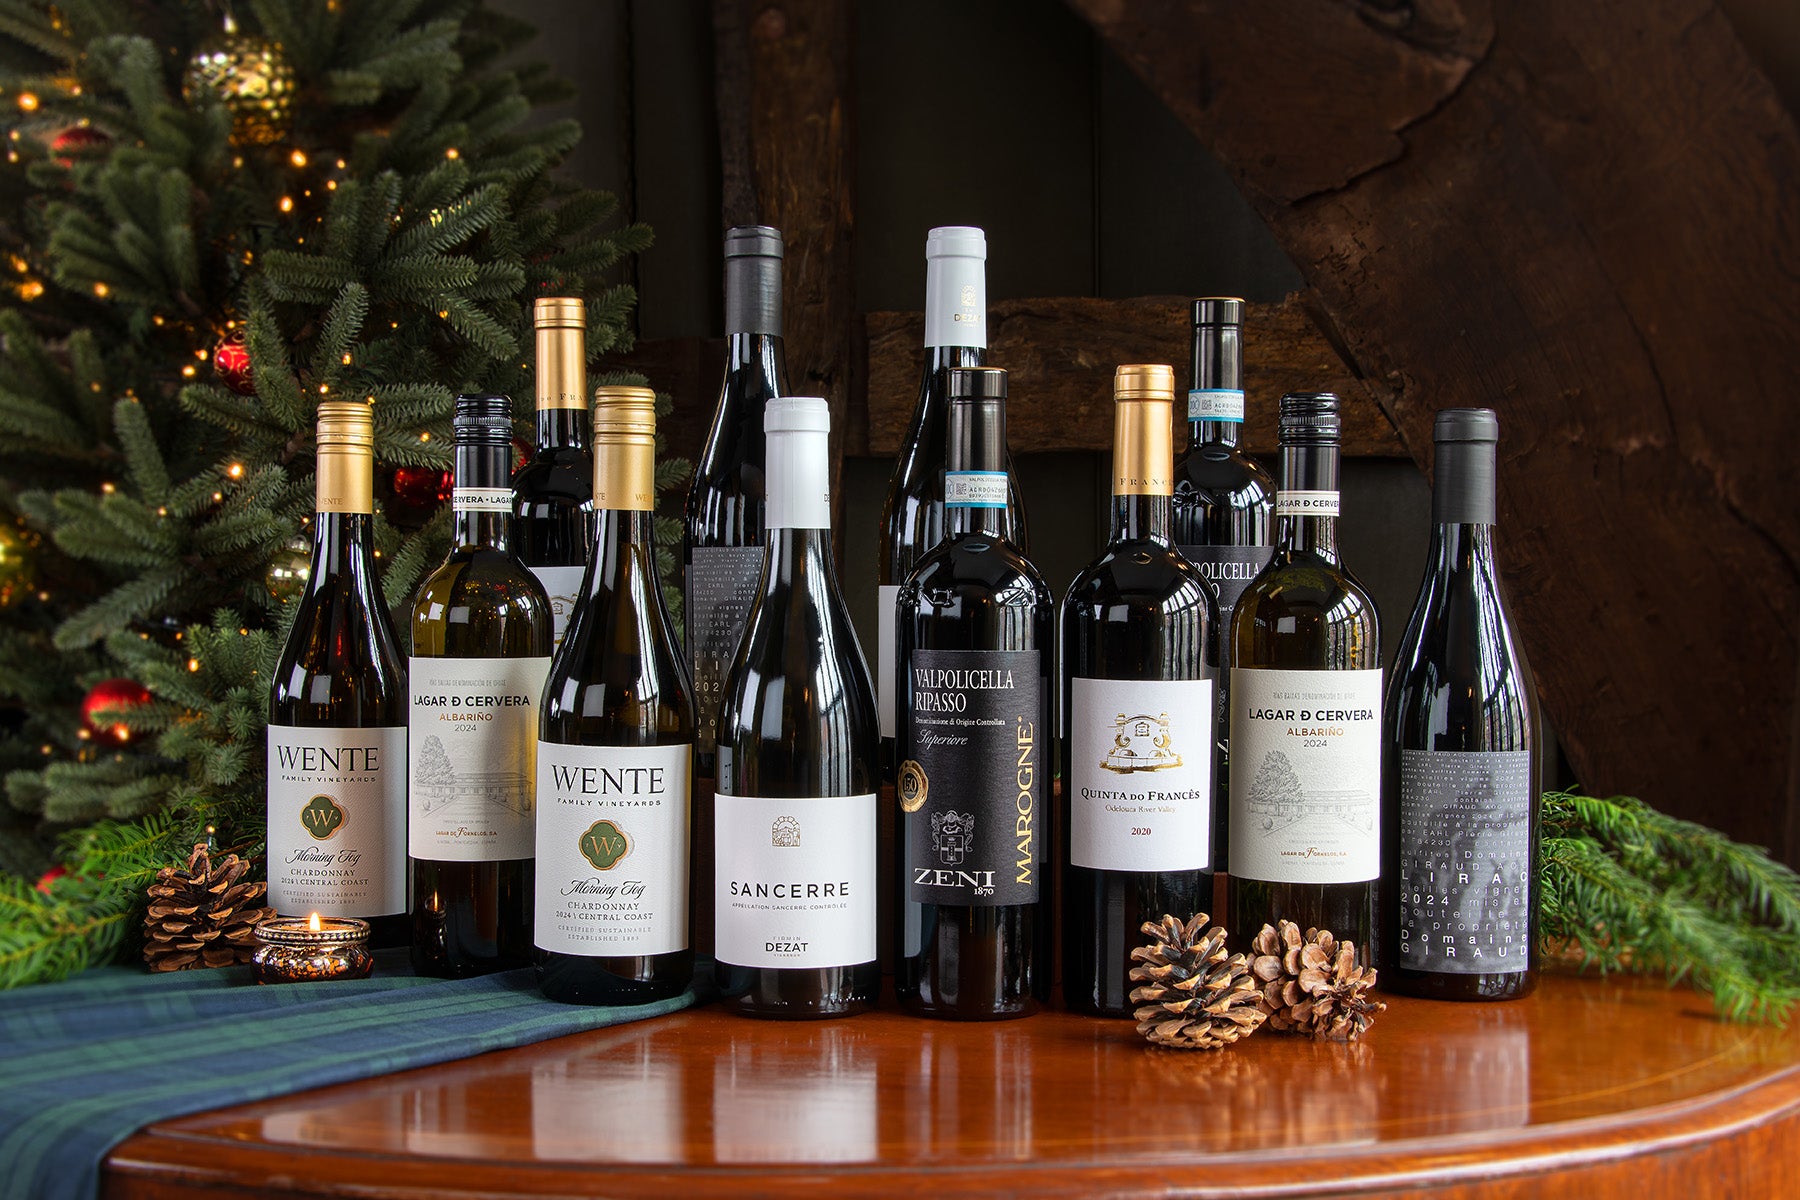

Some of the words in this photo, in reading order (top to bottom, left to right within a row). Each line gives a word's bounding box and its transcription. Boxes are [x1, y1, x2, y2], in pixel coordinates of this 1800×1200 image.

[1194, 562, 1260, 580] POLICELLA
[915, 668, 1015, 689] VALPOLICELLA
[695, 682, 719, 692] 202
[414, 694, 447, 707] LAGAR
[465, 695, 530, 707] CERVERA
[915, 692, 967, 712] RIPASSO
[439, 711, 493, 721] ALBARIÑO
[1249, 708, 1295, 720] LAGAR
[1316, 709, 1373, 721] CERVERA
[454, 724, 477, 732] 2024
[1287, 724, 1344, 736] ALBARIÑO
[917, 729, 968, 750] Superiore
[1303, 739, 1327, 748] 2024
[277, 745, 380, 772] WENTE
[551, 764, 665, 795] WENTE
[1081, 787, 1128, 800] QUINTA
[1148, 788, 1200, 801] FRANCÊS
[557, 798, 592, 806] FAMILY
[597, 799, 661, 807] VINEYARDS
[1138, 804, 1156, 813] River
[1158, 804, 1176, 814] Valley
[310, 809, 334, 827] W
[1131, 827, 1151, 836] 2020
[590, 836, 618, 856] W
[285, 846, 336, 866] Morning
[1401, 859, 1480, 870] GIRAUD
[290, 869, 356, 877] CHARDONNAY
[914, 868, 996, 887] ZENI
[1402, 869, 1528, 884] LIRAC
[300, 878, 338, 886] CENTRAL
[341, 878, 369, 886] COAST
[561, 877, 618, 900] Morning
[730, 881, 849, 898] SANCERRE
[974, 887, 994, 896] 1870
[732, 902, 770, 910] APPELLATION
[1402, 893, 1449, 906] 2024
[567, 902, 640, 911] CHARDONNAY
[579, 913, 621, 921] CENTRAL
[624, 912, 653, 921] COAST
[1401, 929, 1527, 945] Domaine
[765, 942, 808, 952] DEZAT
[1401, 943, 1527, 958] GIRAUD
